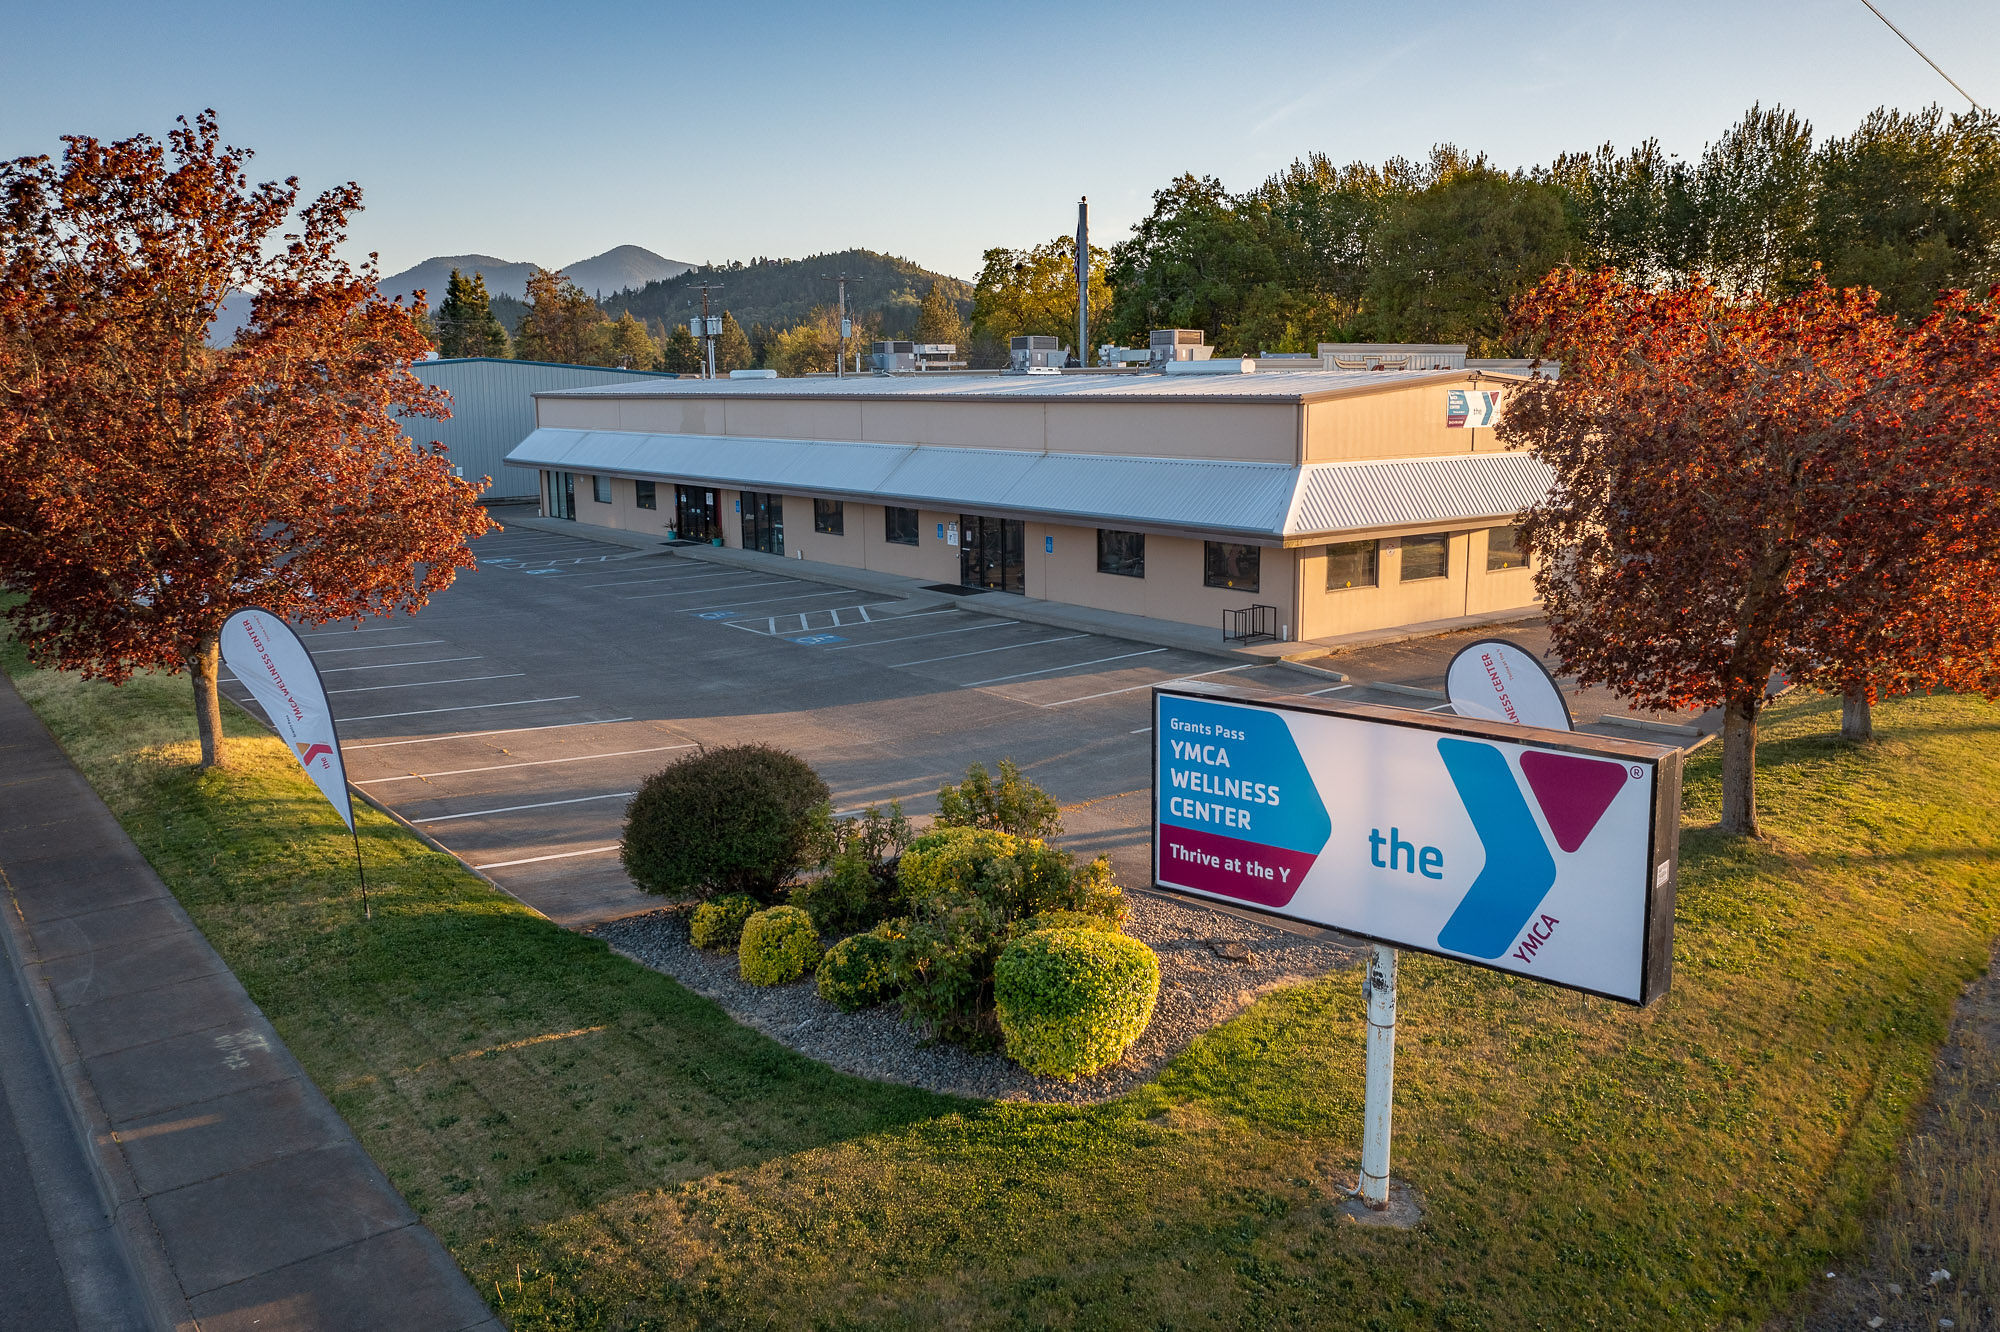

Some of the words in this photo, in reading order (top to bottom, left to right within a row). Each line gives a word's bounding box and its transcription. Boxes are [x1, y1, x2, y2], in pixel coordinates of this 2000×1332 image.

[242, 618, 265, 653] CENTER
[260, 653, 291, 697] WELLNESS
[1481, 652, 1505, 693] CENTER
[287, 696, 304, 722] YMCA
[1499, 693, 1521, 724] LNESS
[1170, 717, 1212, 736] Grants
[1215, 724, 1245, 741] Pass
[319, 756, 330, 770] the
[1170, 738, 1231, 768] YMCA
[1170, 767, 1280, 806] WELLNESS
[1169, 796, 1252, 831] CENTER
[1169, 842, 1220, 868] Thrive
[1224, 858, 1242, 874] at
[1246, 860, 1274, 880] the
[1278, 866, 1291, 883] Y
[1368, 826, 1444, 880] the
[1512, 913, 1560, 964] YMCA
